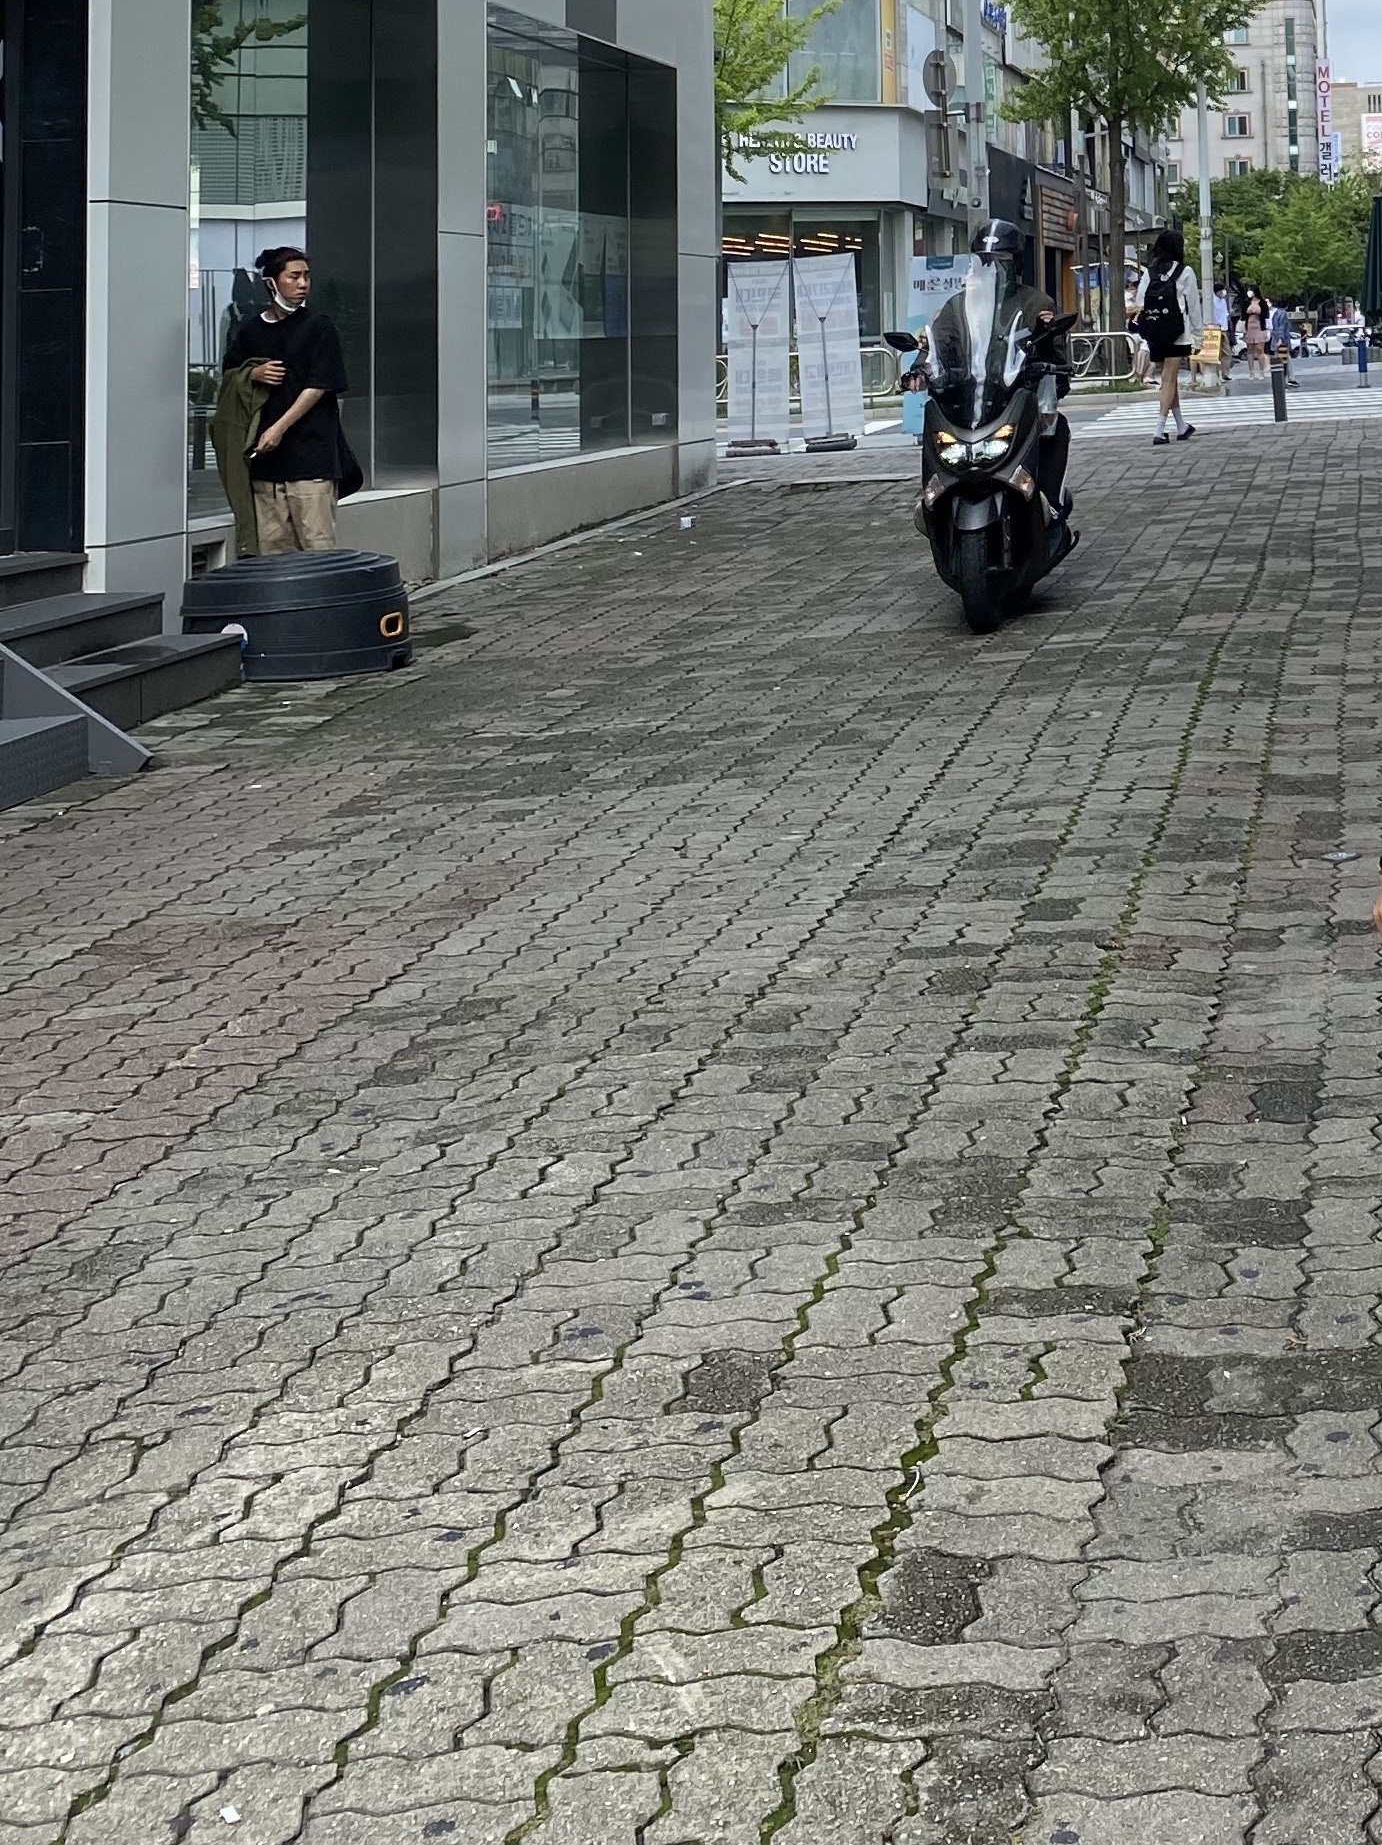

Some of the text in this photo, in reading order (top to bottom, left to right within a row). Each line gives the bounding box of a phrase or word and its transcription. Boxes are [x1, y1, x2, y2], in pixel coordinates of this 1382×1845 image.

[1318, 66, 1331, 137] MOTEL
[808, 133, 857, 150] BEAUTY
[769, 152, 830, 174] STORE
